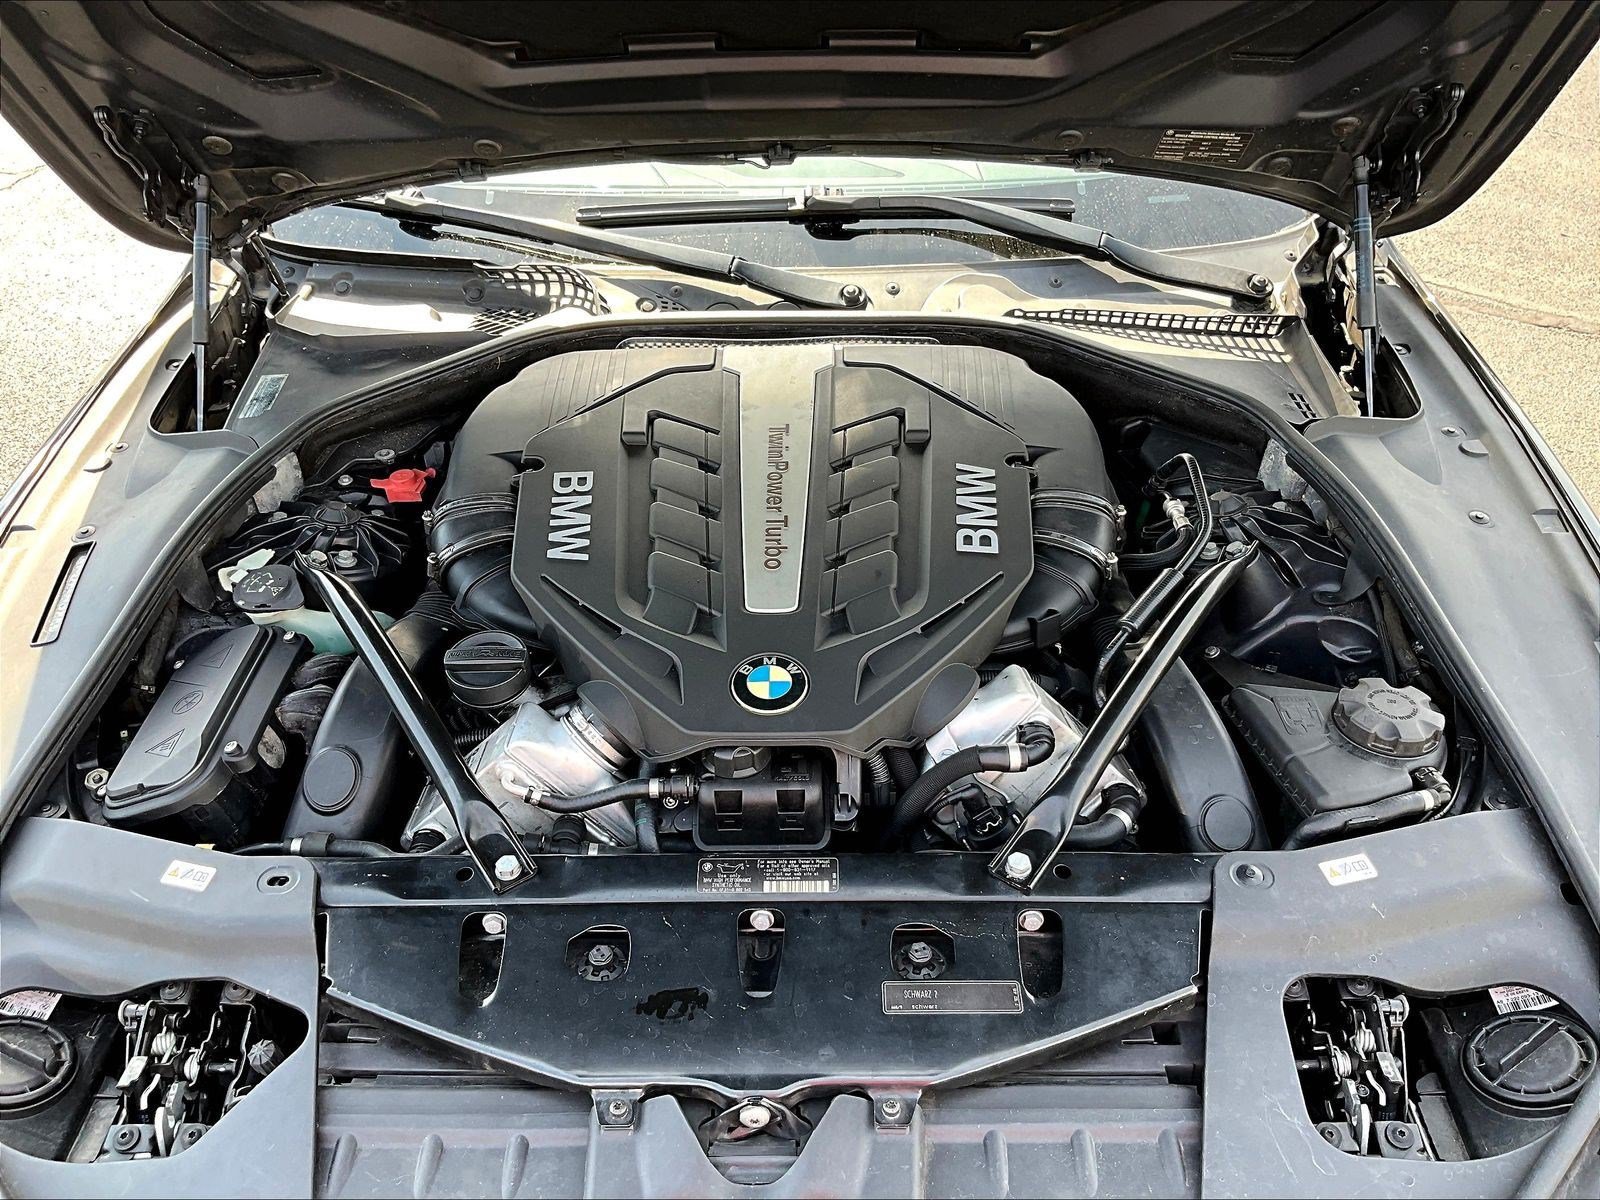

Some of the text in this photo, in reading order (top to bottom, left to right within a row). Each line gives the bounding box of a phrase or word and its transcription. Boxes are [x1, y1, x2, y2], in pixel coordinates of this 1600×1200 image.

[546, 471, 594, 560] BMW
[763, 423, 790, 570] TwinPower Turbo
[956, 462, 999, 553] BMW
[739, 657, 802, 675] BMW
[903, 989, 932, 999] SCHWARZ
